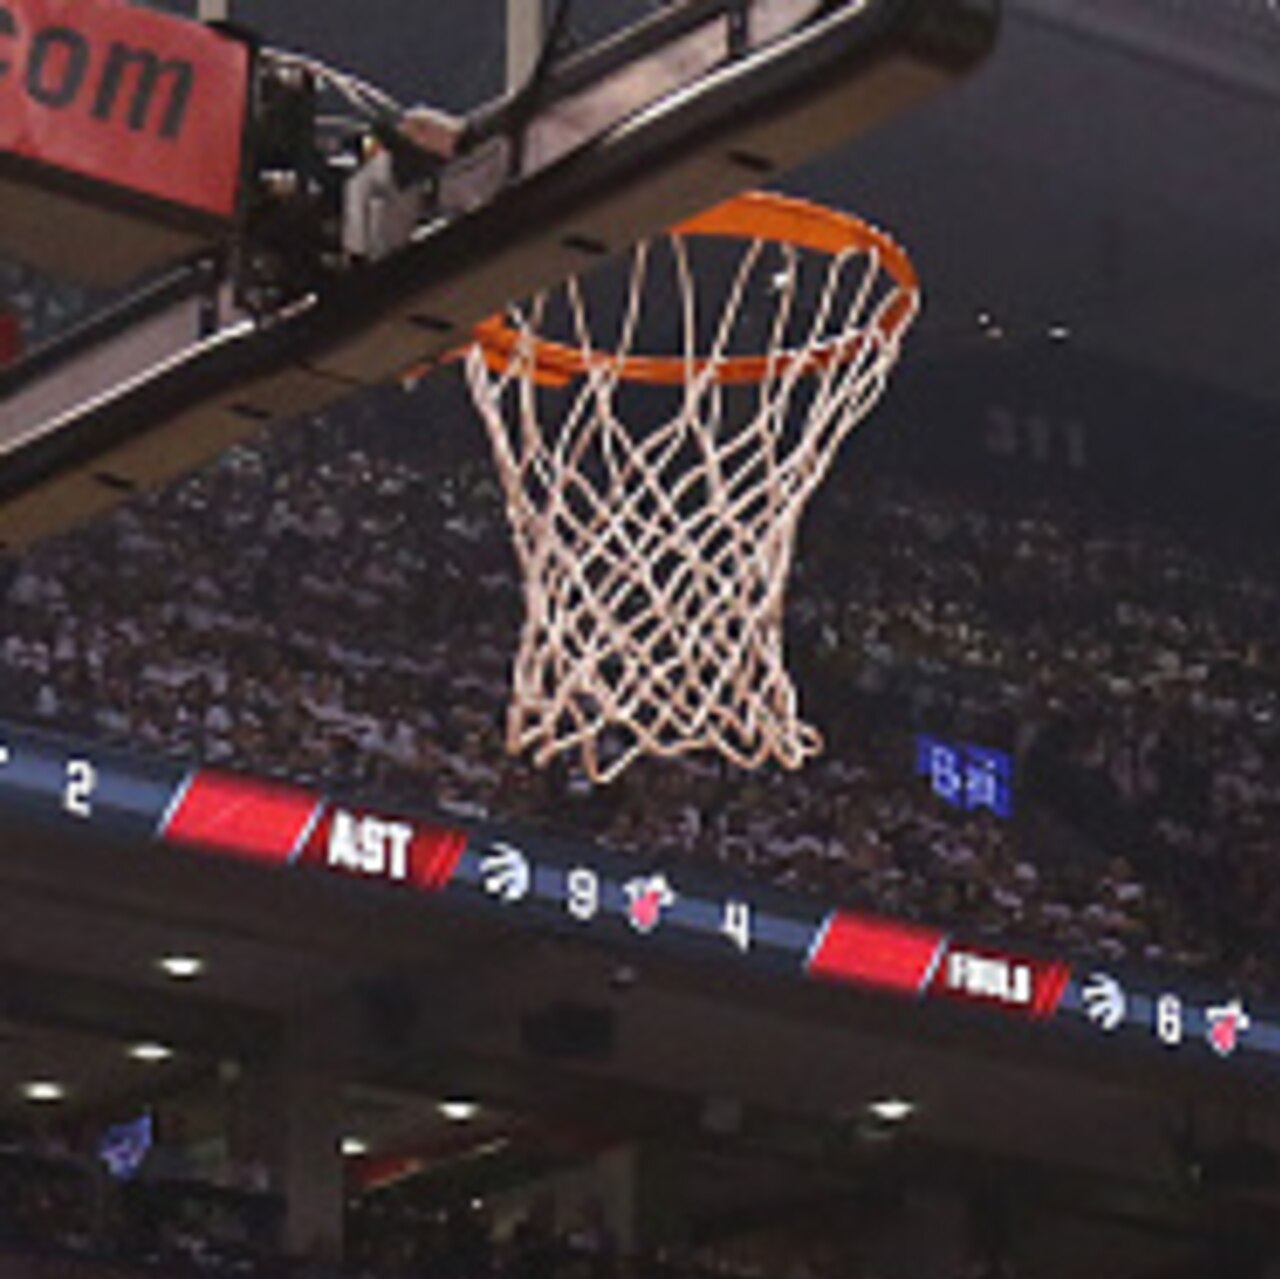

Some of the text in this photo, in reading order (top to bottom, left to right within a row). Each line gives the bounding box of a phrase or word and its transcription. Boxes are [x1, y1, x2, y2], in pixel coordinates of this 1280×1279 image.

[64, 760, 96, 817] 2
[327, 811, 413, 878] AST
[568, 869, 598, 920] 9
[721, 902, 749, 952] 4
[1158, 994, 1182, 1044] 6
